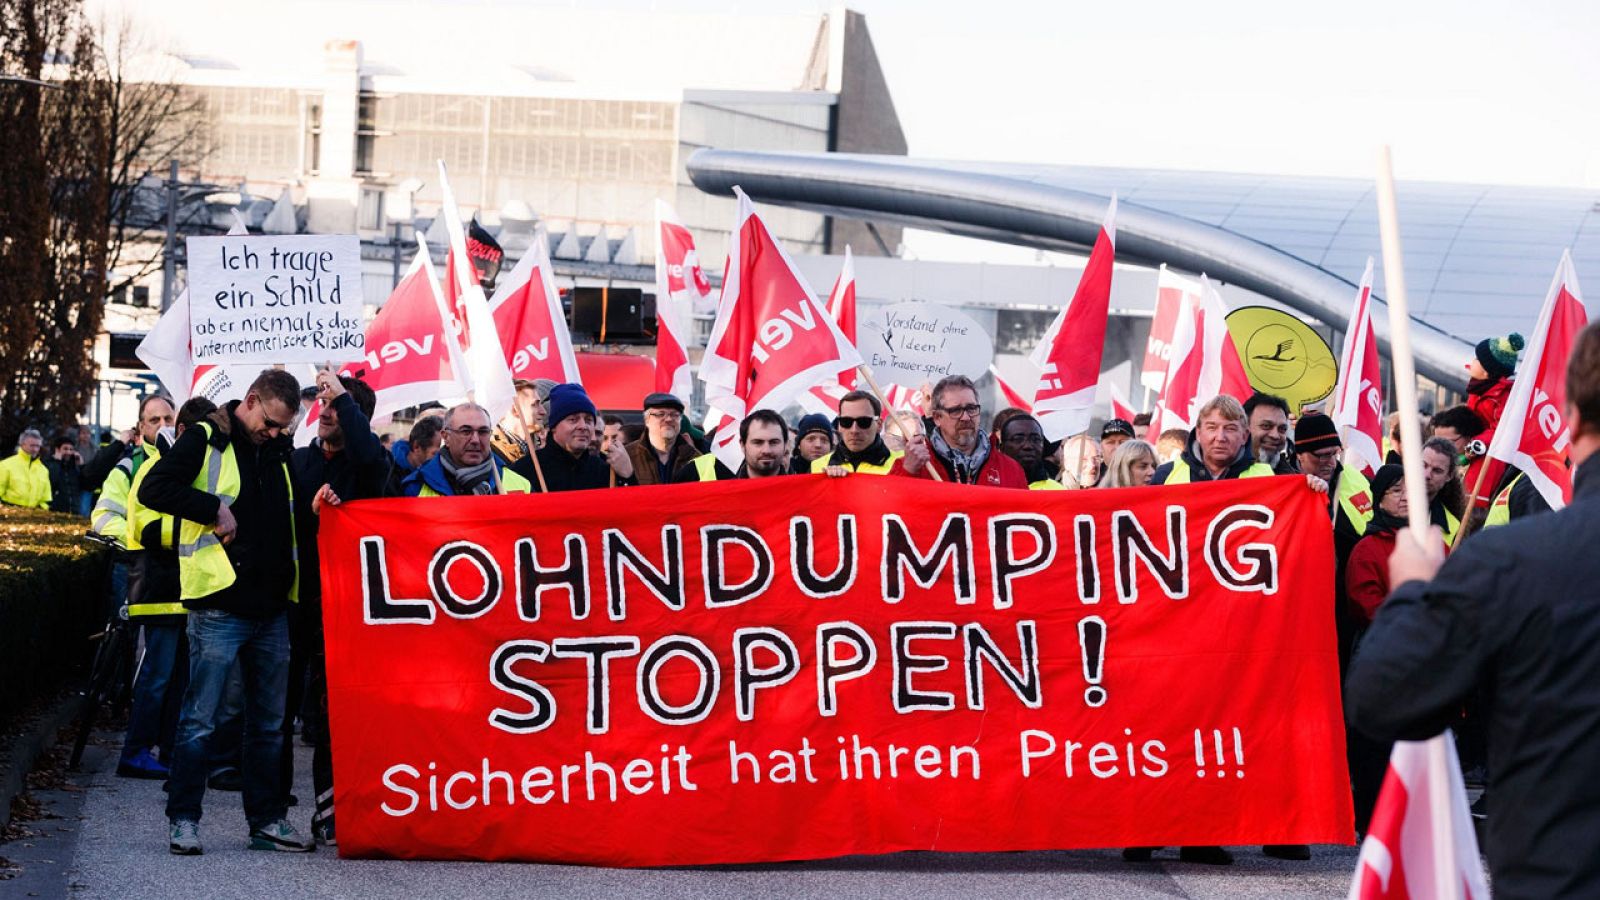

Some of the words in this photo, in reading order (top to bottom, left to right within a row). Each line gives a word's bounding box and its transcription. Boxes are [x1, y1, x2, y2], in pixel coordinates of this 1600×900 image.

[222, 244, 259, 270] Ich
[270, 246, 333, 282] trage
[214, 282, 254, 309] ein
[264, 274, 341, 307] Schild
[195, 317, 235, 336] aber
[241, 311, 323, 333] niemals
[328, 311, 358, 330] das
[312, 331, 365, 350] Risiko
[885, 311, 939, 334] Vorstand
[942, 321, 969, 336] ohne
[871, 353, 887, 366] Ein
[359, 504, 1278, 626] LOHNDUMPING
[488, 619, 1043, 735] STOPPEN
[380, 744, 698, 817] Sicherheit
[729, 736, 818, 784] hat
[836, 734, 981, 780] ihren
[1020, 727, 1169, 778] Preis
[1194, 726, 1246, 778] !!!
